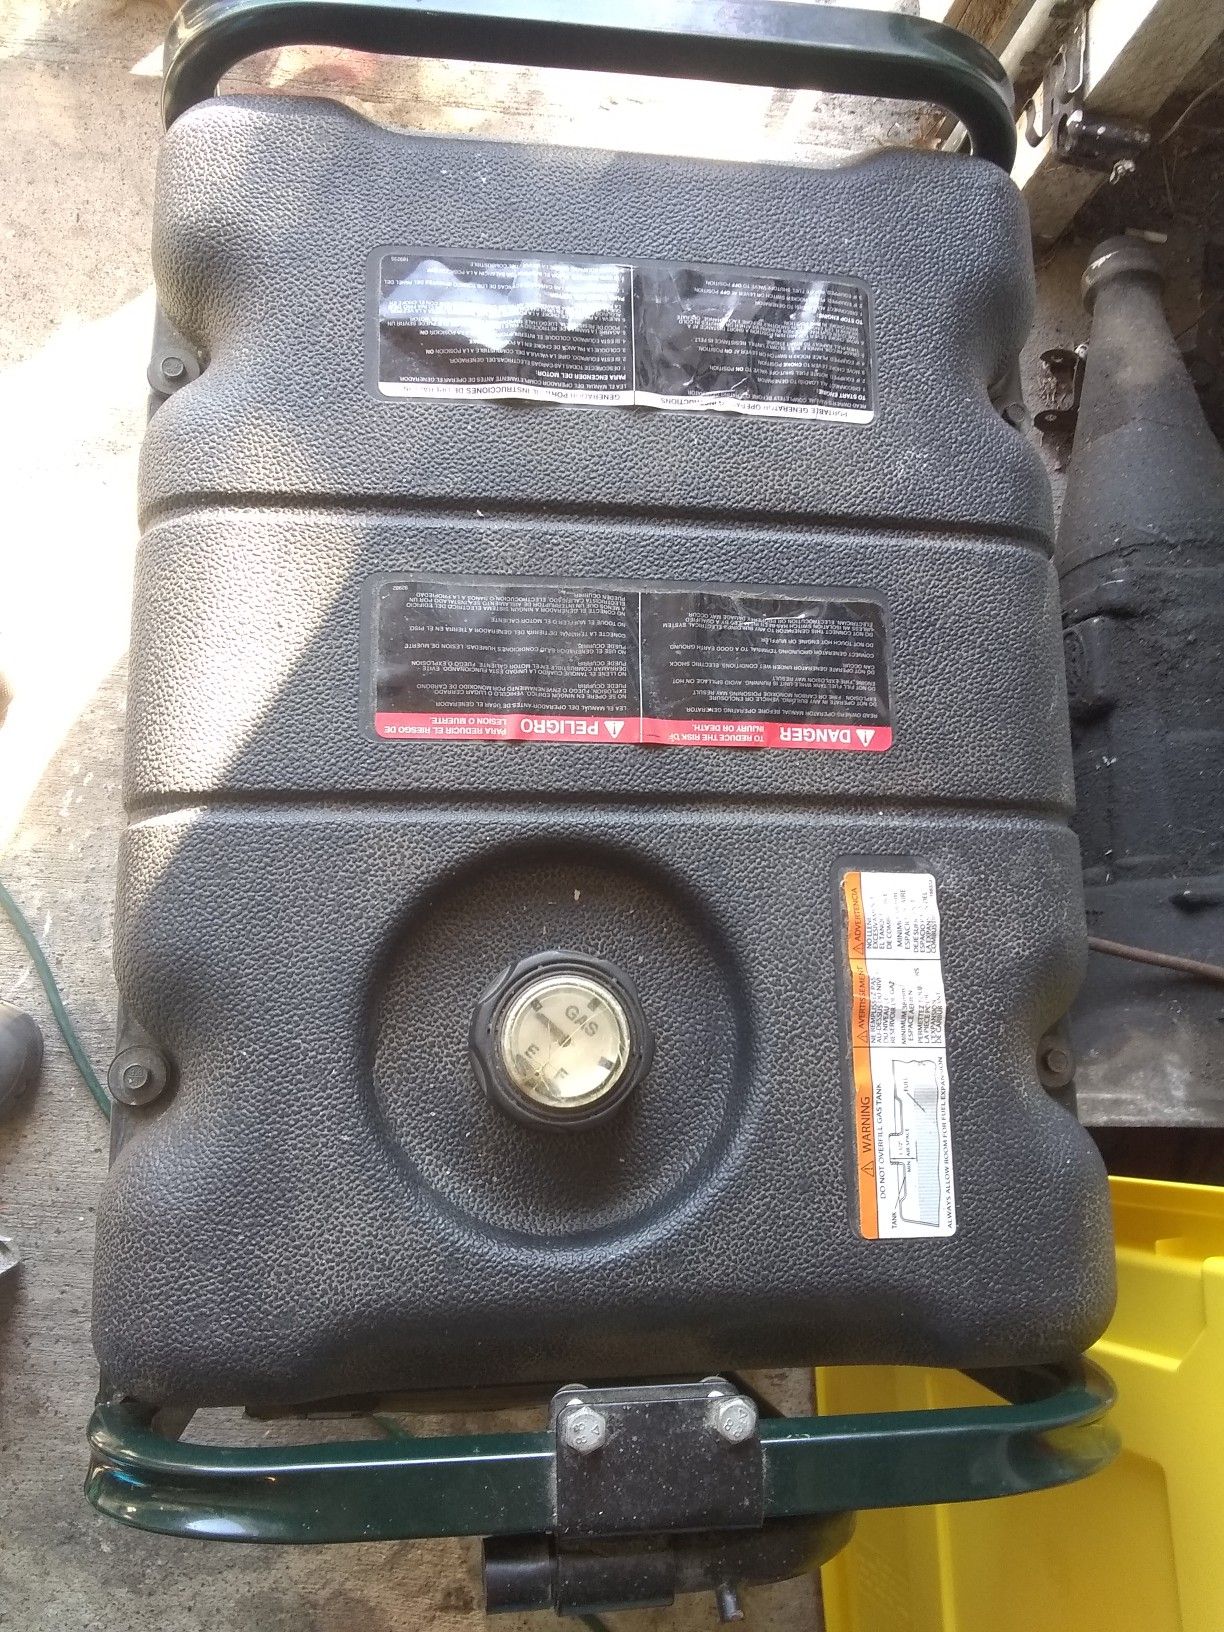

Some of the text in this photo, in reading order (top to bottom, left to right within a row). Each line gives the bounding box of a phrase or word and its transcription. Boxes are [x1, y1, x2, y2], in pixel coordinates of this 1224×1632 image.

[445, 727, 483, 735] REDUCIR
[485, 727, 507, 735] PARA
[520, 719, 599, 735] PELIGRO
[780, 727, 851, 743] DANGER
[851, 888, 861, 941] ADVERTENCIA
[857, 966, 866, 1029] AVERTISSEMENT
[565, 1005, 598, 1036] GAS
[861, 1097, 871, 1152] WARNING
[880, 1186, 886, 1199] DO
